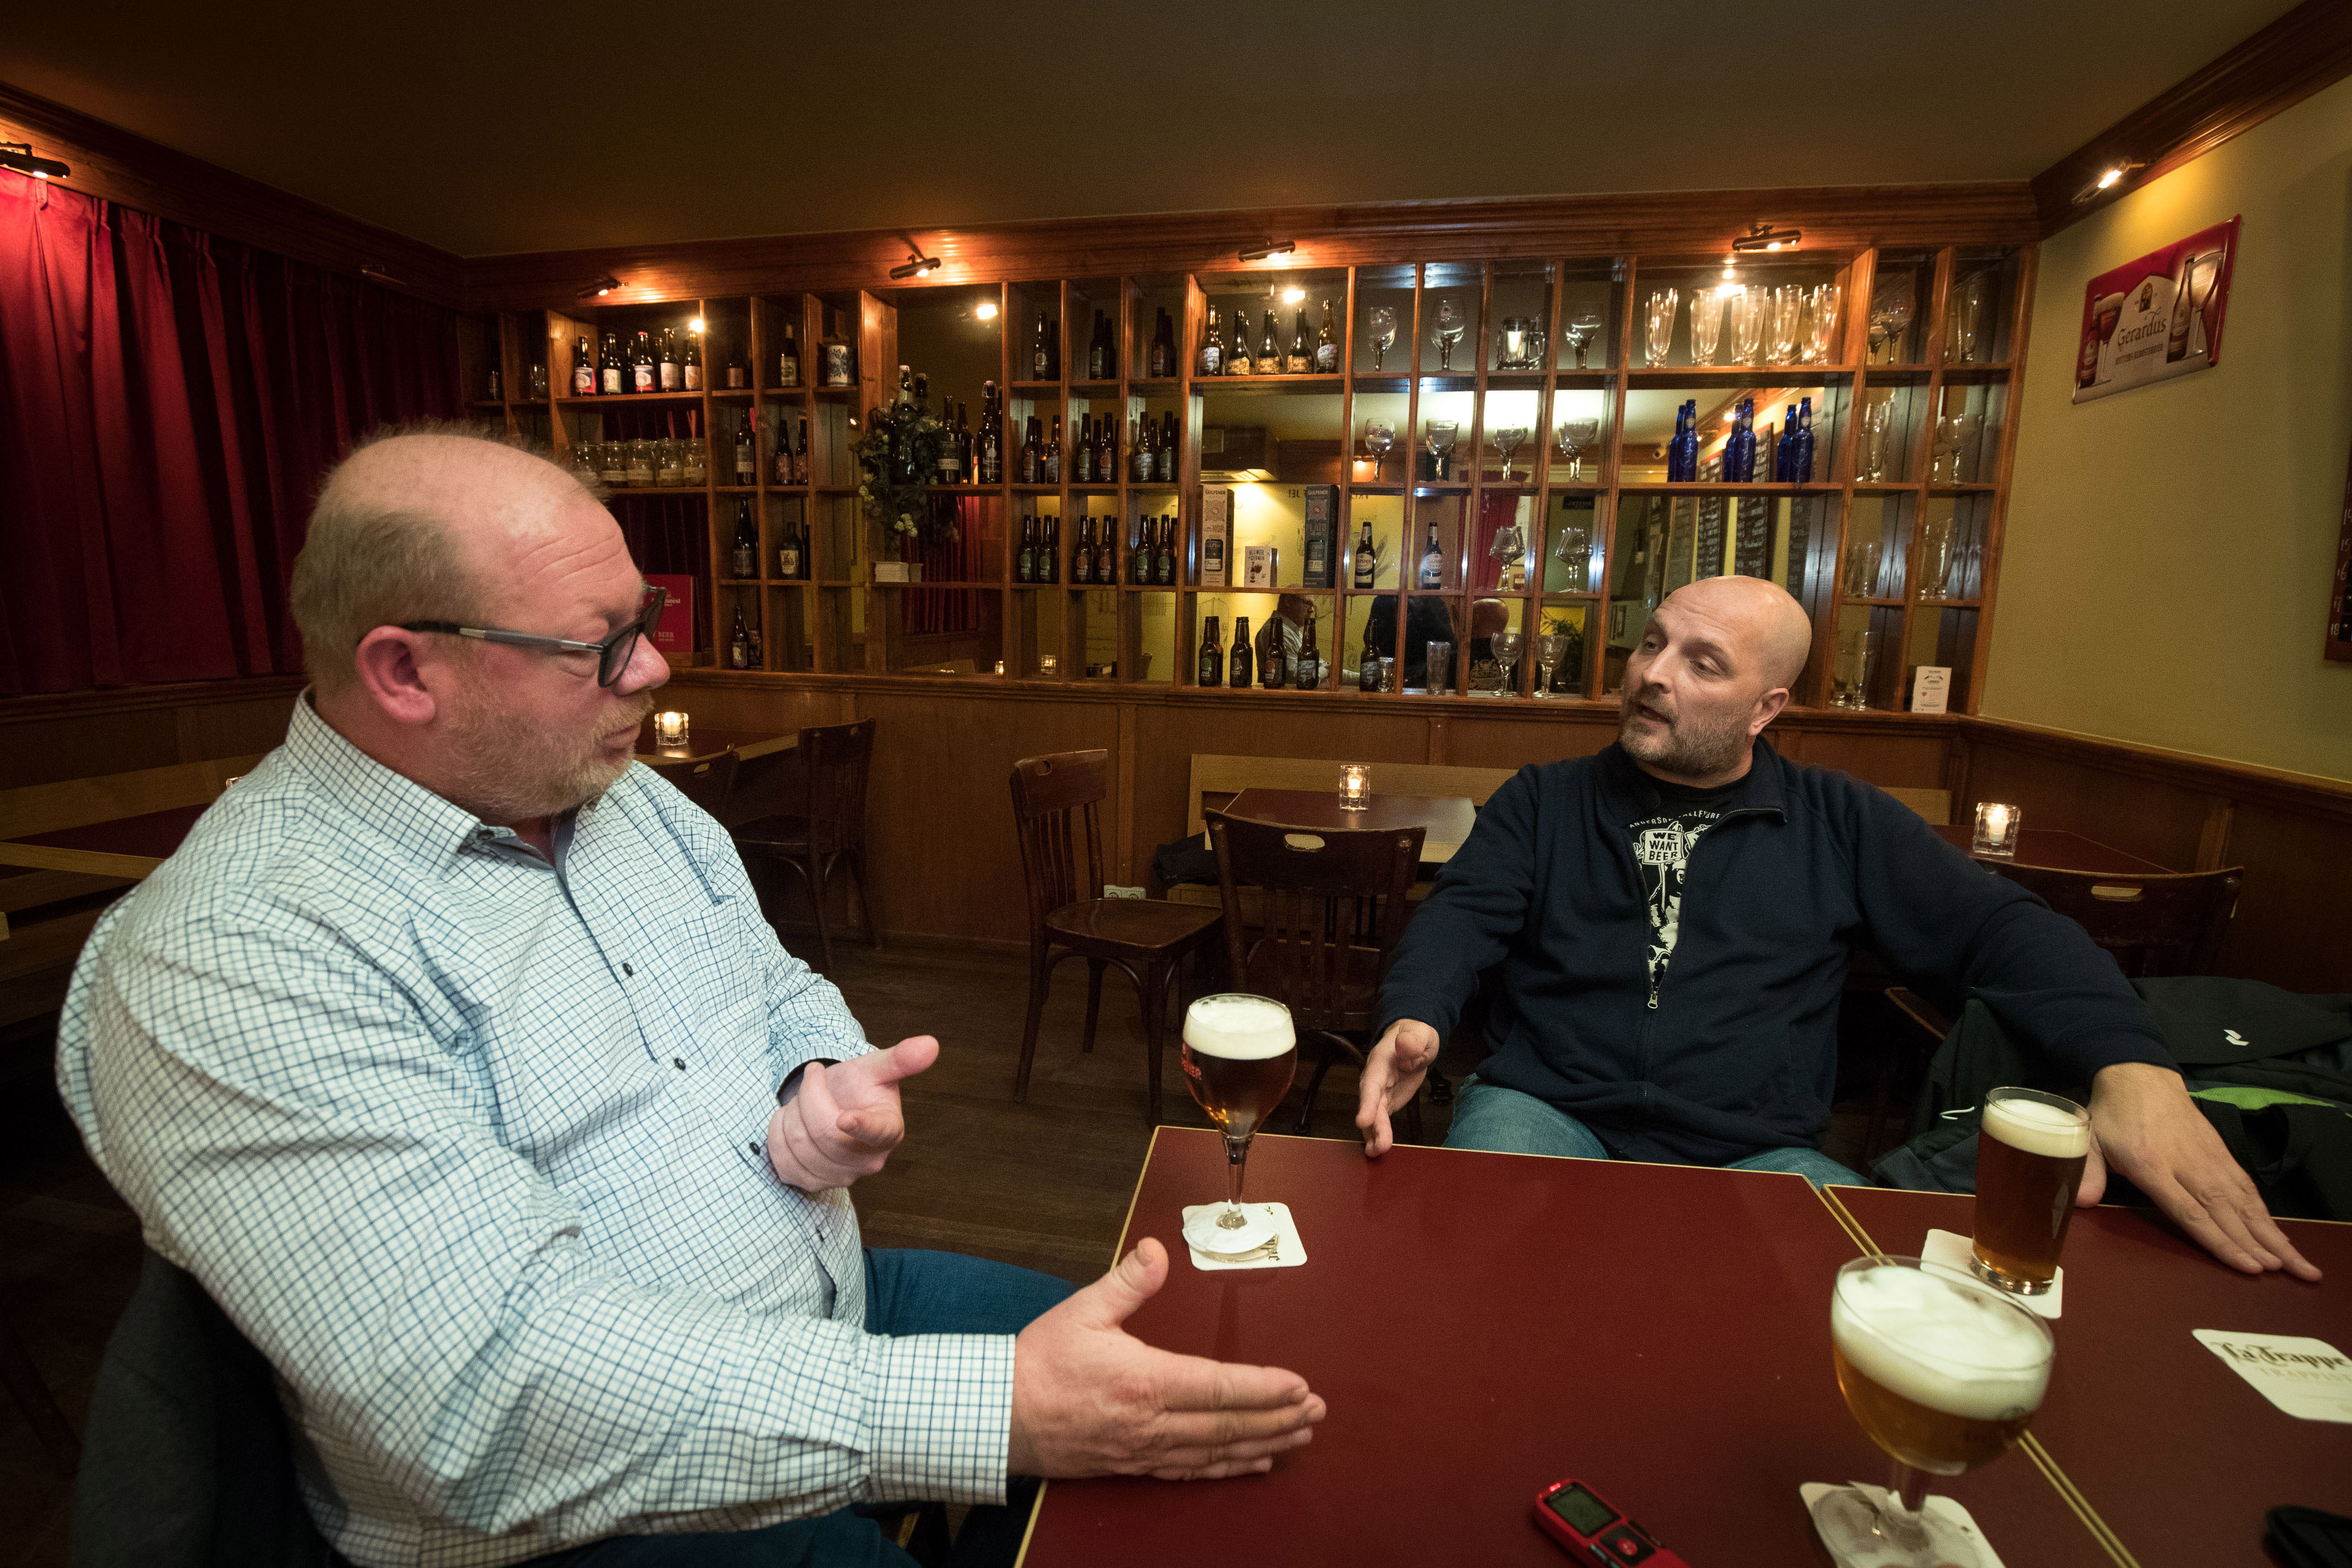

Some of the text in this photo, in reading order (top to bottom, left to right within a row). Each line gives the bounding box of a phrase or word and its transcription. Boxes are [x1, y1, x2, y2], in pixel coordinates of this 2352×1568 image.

[2117, 308, 2167, 351] Gerardus
[1652, 832, 1677, 841] WE
[1649, 840, 1678, 852] WANT
[1649, 851, 1678, 861] BEER
